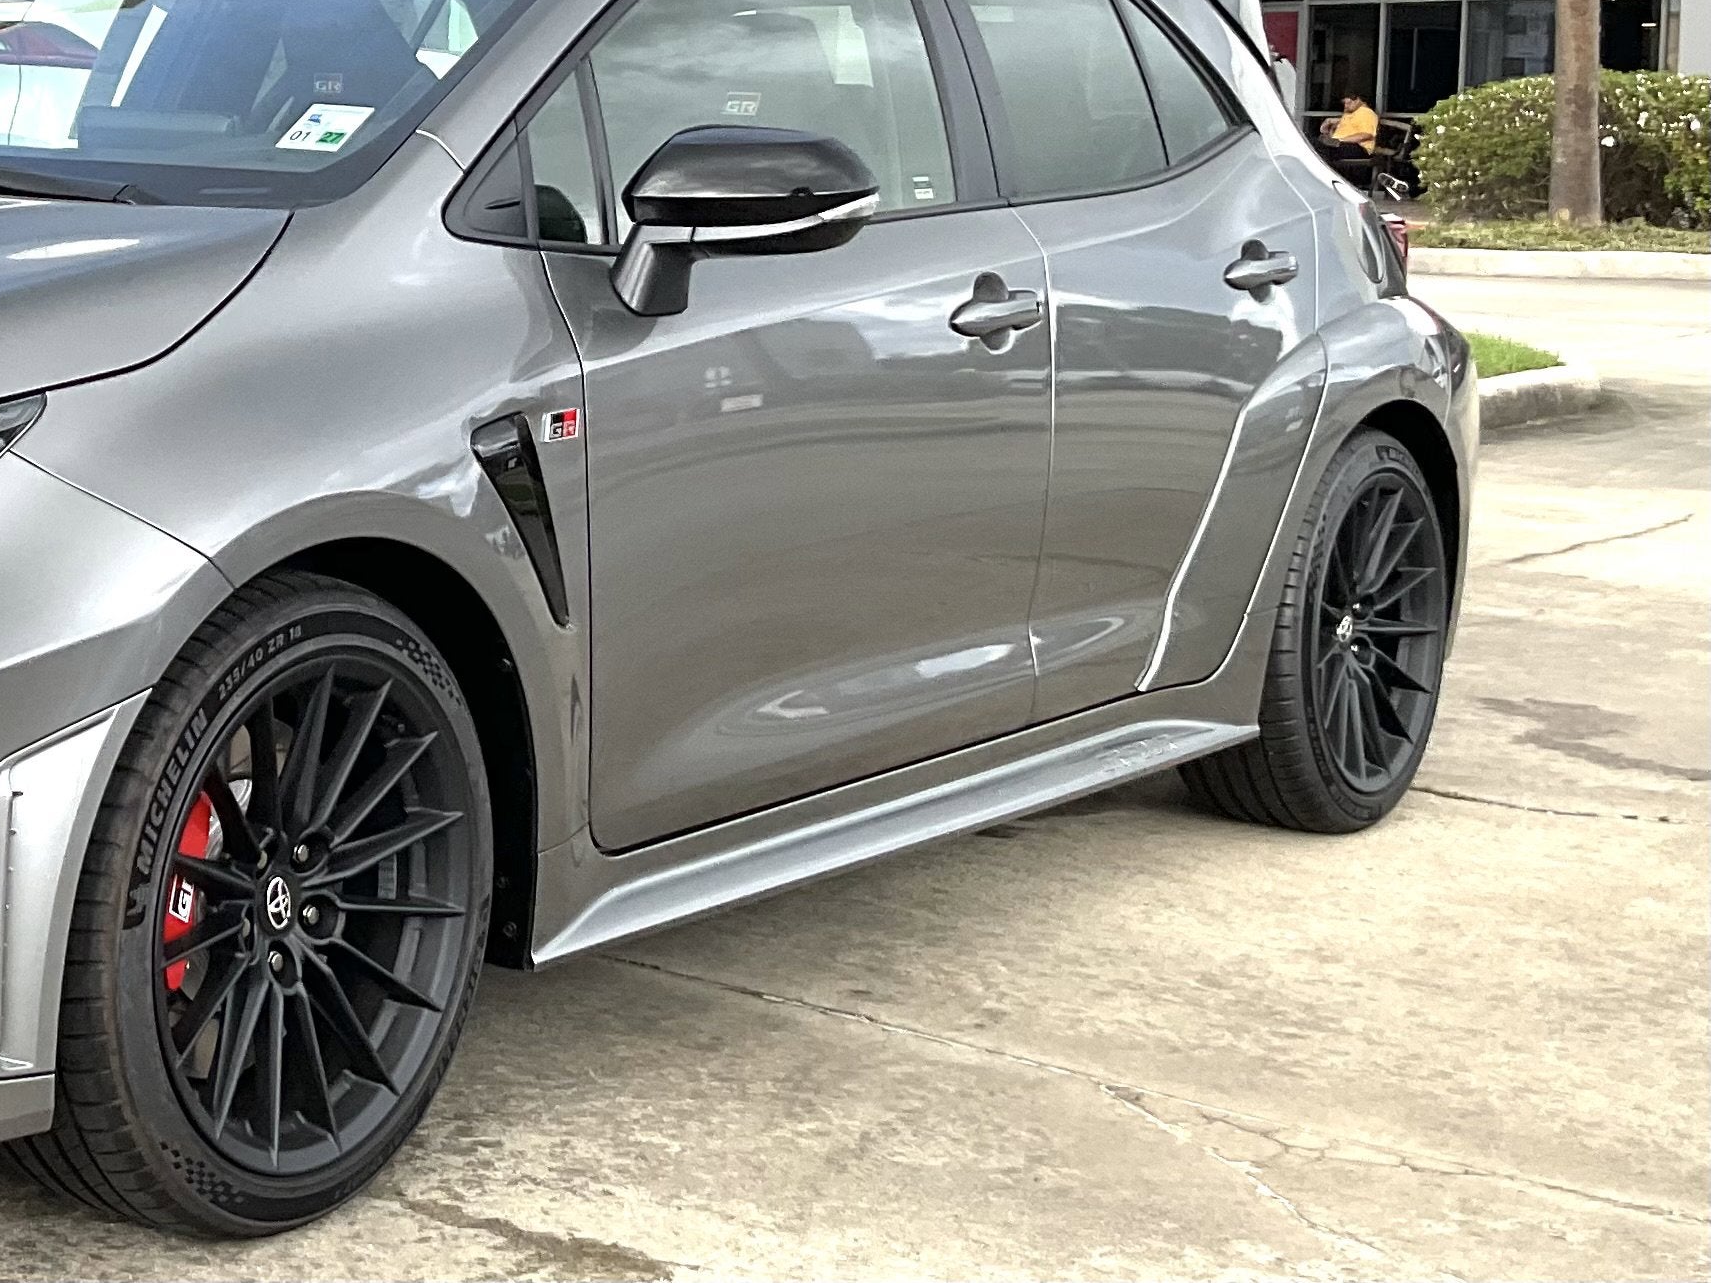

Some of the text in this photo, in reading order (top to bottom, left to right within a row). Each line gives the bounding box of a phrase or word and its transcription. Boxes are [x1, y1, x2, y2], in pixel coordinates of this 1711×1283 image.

[289, 130, 312, 142] 01
[318, 131, 346, 144] 27
[549, 419, 576, 438] GR
[137, 706, 208, 875] MICHELIN
